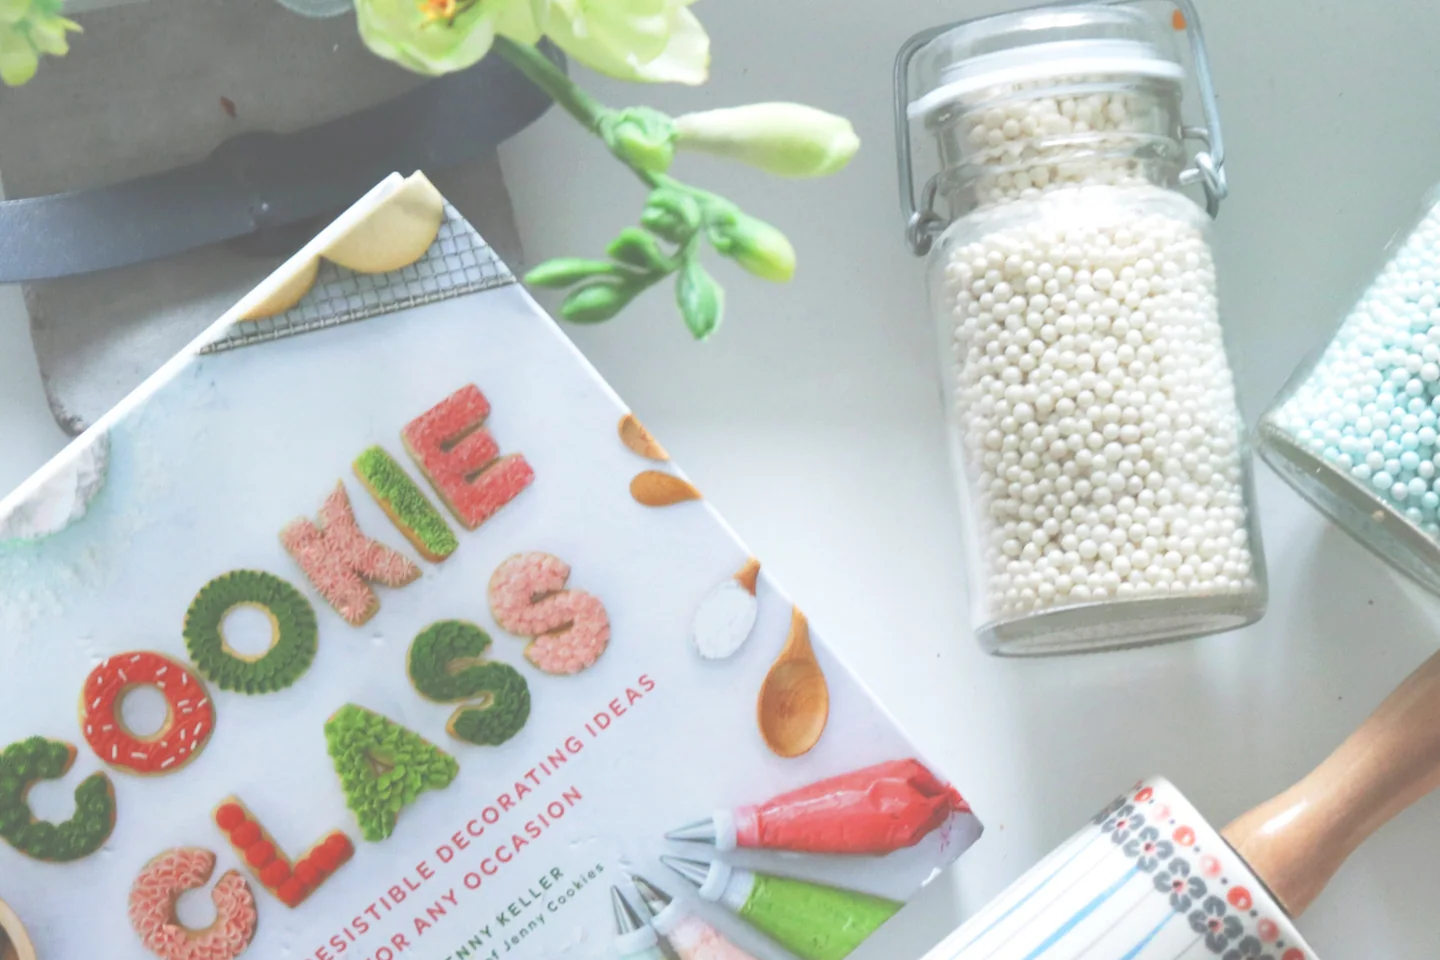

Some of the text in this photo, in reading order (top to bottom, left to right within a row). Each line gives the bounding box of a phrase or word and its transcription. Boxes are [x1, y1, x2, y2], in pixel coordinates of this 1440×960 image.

[0, 384, 535, 863] COOKIE
[436, 736, 584, 863] DECORATING
[585, 674, 656, 737] IDEAS
[414, 889, 458, 935] ANY
[464, 786, 583, 891] OCCASION
[496, 867, 563, 927] KELLER
[504, 913, 545, 952] Jenny
[547, 863, 604, 912] Cookies
